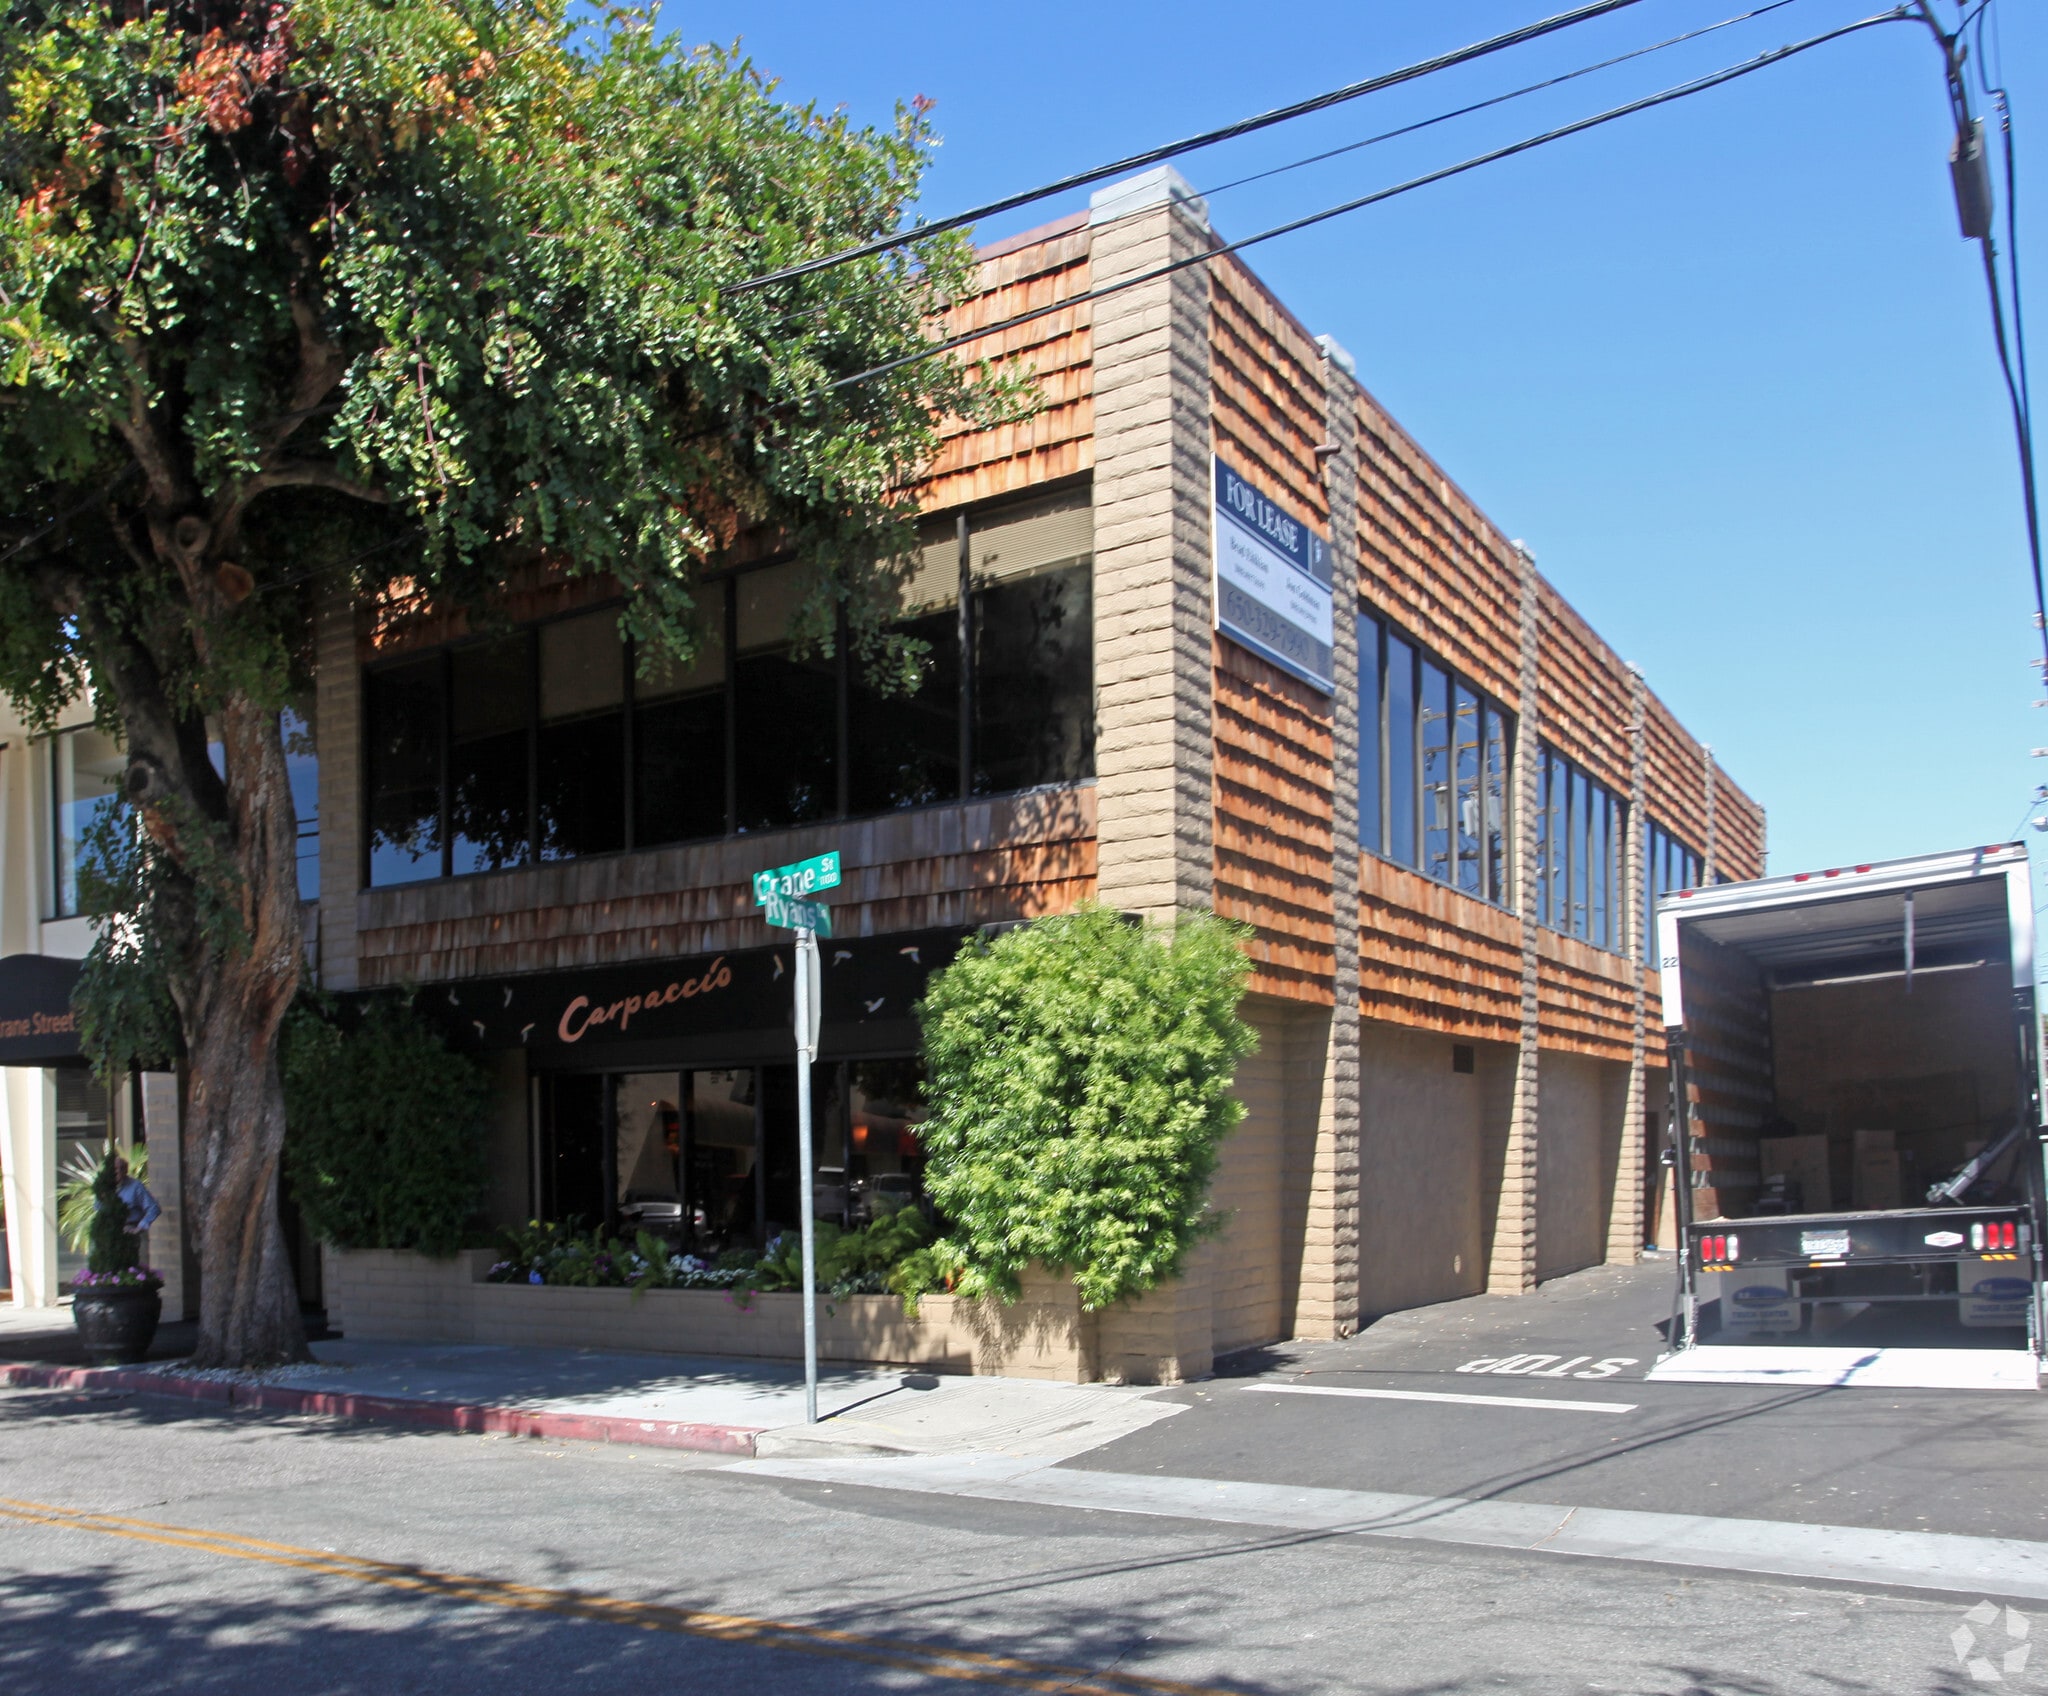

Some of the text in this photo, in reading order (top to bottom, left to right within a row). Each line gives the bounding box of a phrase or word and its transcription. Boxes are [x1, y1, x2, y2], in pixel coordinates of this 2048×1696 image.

[1226, 473, 1299, 553] FOR LEASE
[756, 857, 834, 901] Crane St
[766, 891, 817, 928] Ryans
[1662, 956, 1679, 969] 22
[558, 956, 732, 1044] Carpaccio
[0, 1011, 75, 1038] rane Street
[1455, 1353, 1639, 1379] STOP
